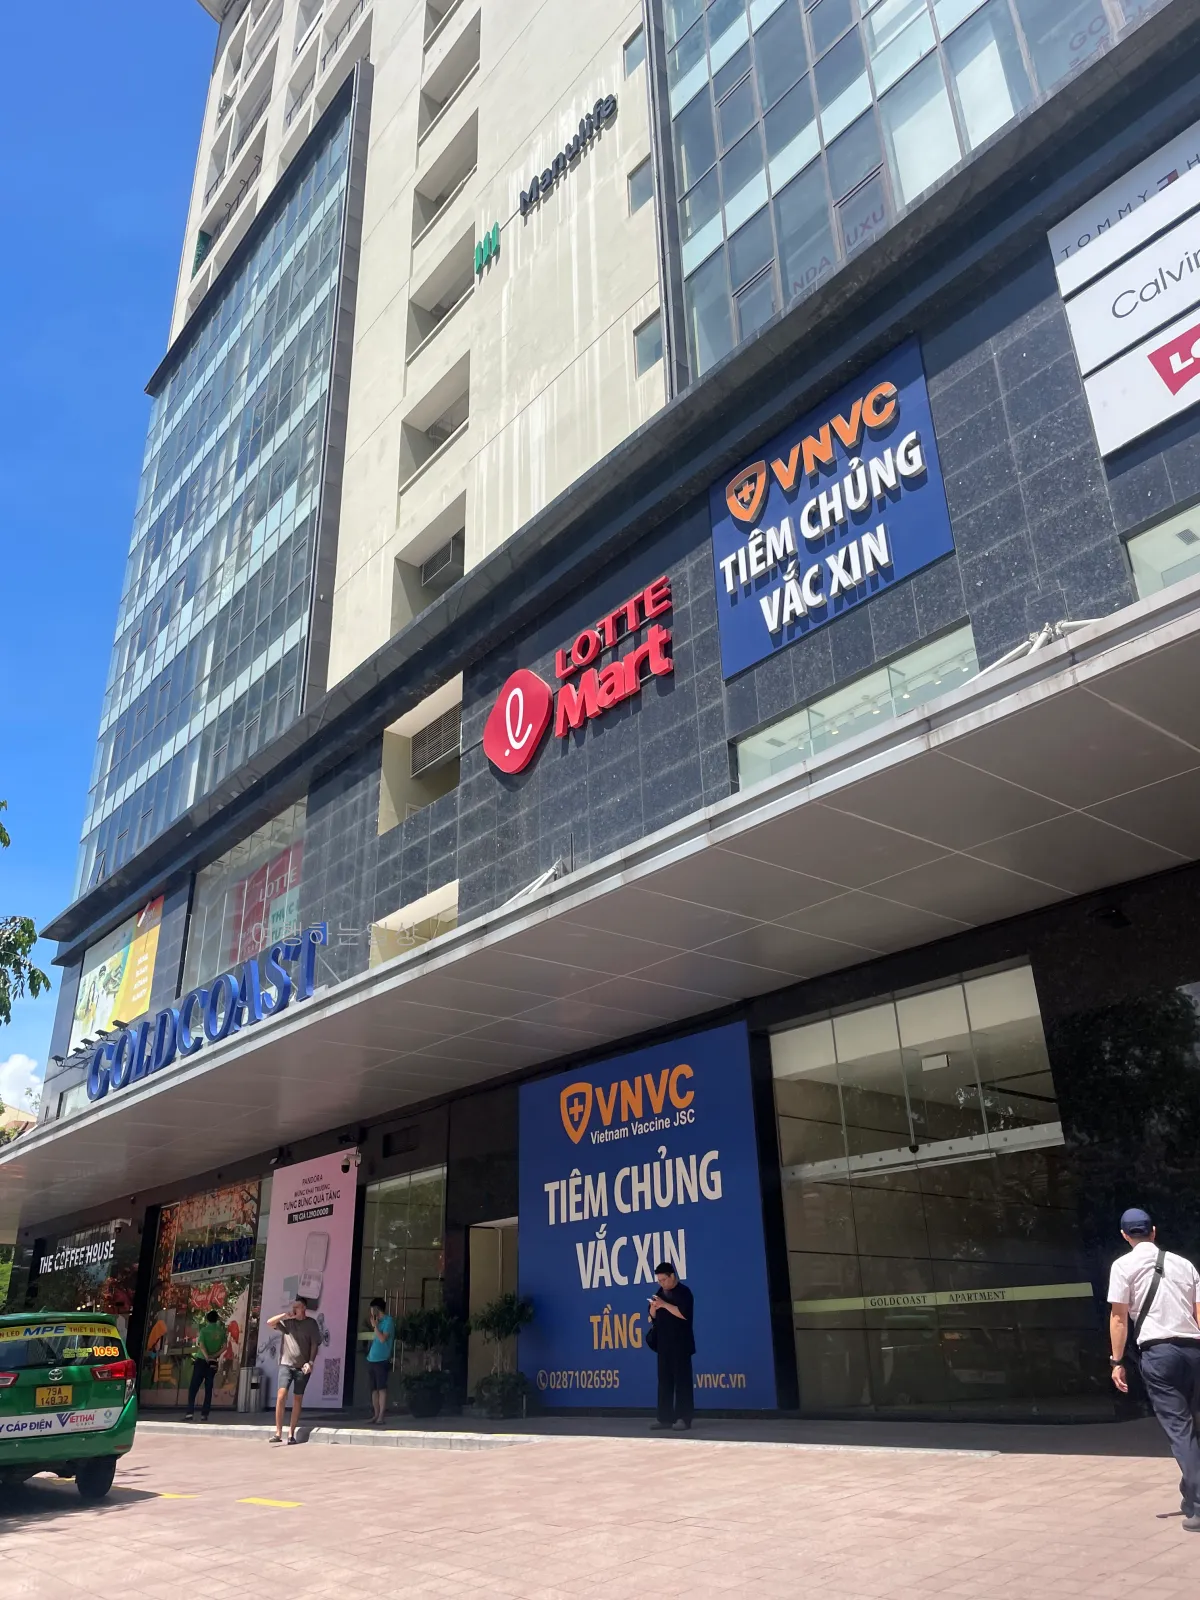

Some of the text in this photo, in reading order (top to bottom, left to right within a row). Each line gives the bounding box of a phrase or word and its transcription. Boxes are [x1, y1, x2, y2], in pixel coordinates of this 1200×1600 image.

[519, 93, 617, 217] Manulife
[1060, 189, 1149, 259] TOMMY
[770, 381, 899, 492] VNVC
[719, 430, 928, 594] TIÊM CHỦNG
[759, 523, 894, 634] VẮC XIN
[555, 575, 673, 680] LOTTE
[554, 623, 674, 738] Mart
[595, 1063, 695, 1126] VNVC
[590, 1108, 695, 1146] Vietnam Vaccine JSC
[302, 1174, 323, 1186] PANDORA
[544, 1146, 723, 1226] TIÊM CHỦNG
[39, 1239, 116, 1274] THE COFFEE HOUSE
[576, 1223, 687, 1290] VẮC XIN
[590, 1304, 642, 1350] TẦNG
[870, 1290, 1006, 1307] GOLDCOAST APARTMENT
[6, 1330, 20, 1338] LED
[23, 1325, 67, 1337] MPE
[93, 1346, 119, 1357] 1055
[549, 1370, 620, 1390] 02871026595
[6, 1420, 28, 1432] CÁP
[29, 1418, 52, 1432] ĐIỆN
